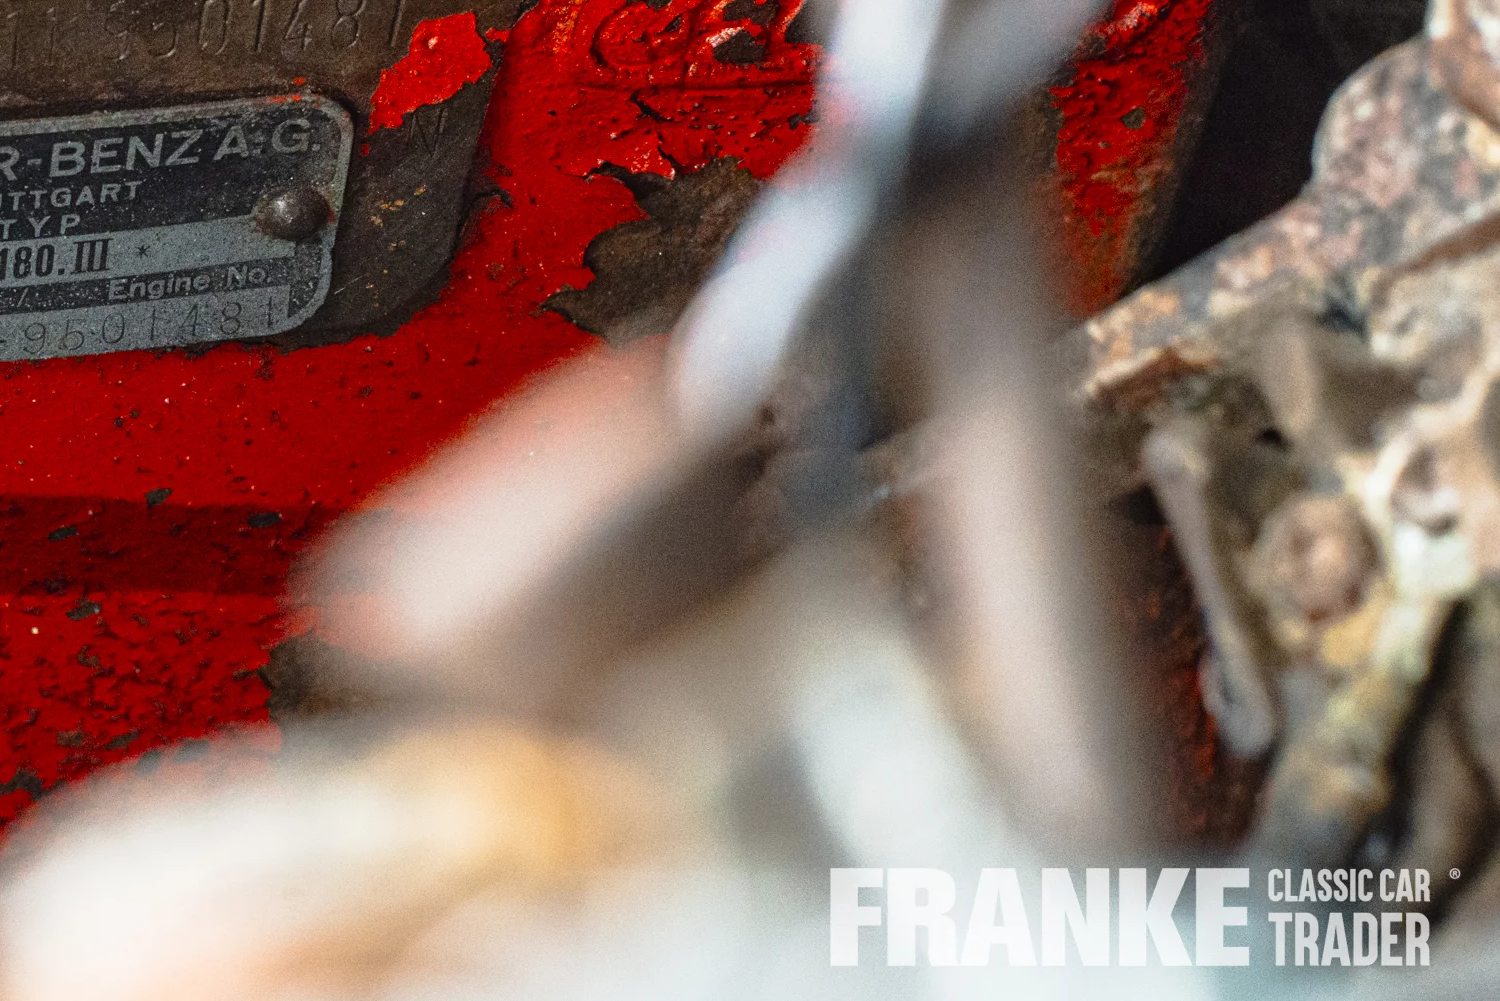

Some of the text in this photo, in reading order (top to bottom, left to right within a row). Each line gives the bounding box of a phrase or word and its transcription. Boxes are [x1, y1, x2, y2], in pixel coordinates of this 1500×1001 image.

[0, 214, 82, 241] TYP
[109, 272, 212, 300] Engine
[225, 265, 272, 288] No.
